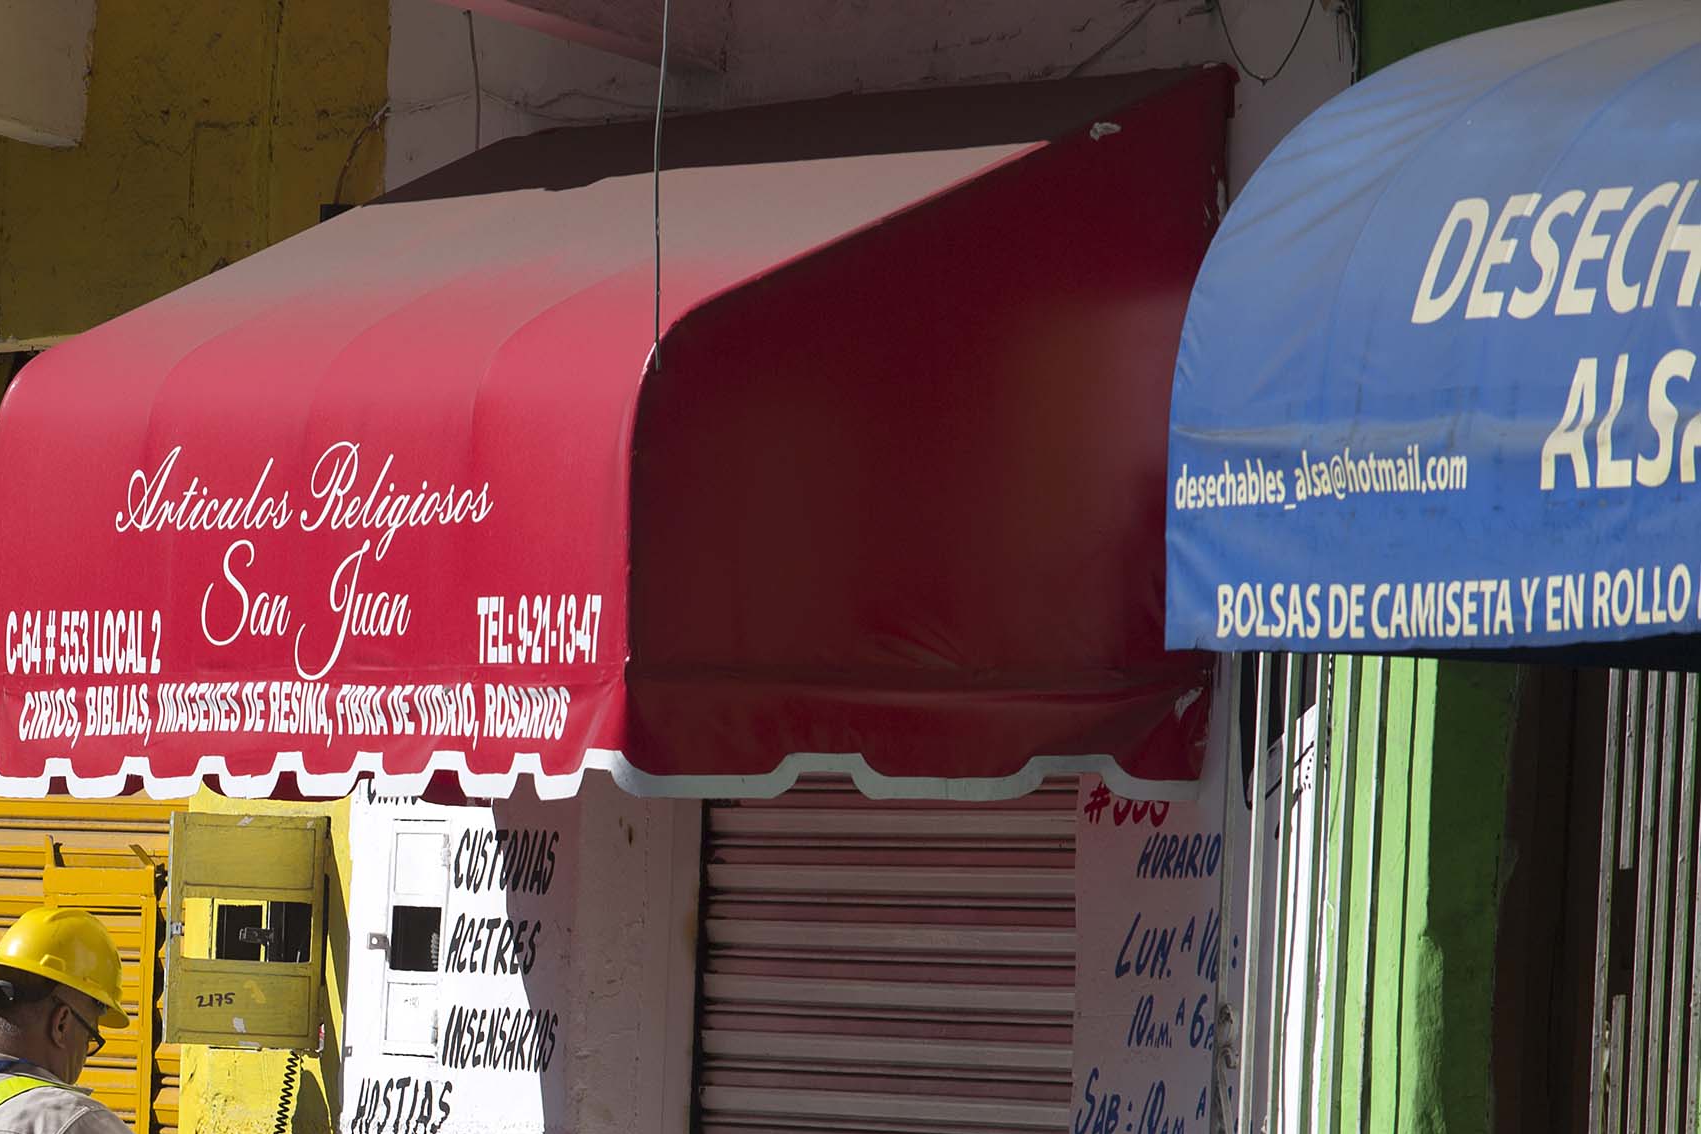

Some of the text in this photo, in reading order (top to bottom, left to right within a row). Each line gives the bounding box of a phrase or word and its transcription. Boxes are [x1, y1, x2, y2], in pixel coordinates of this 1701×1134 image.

[115, 440, 494, 561] Articulos Religiosos
[201, 538, 412, 682] San Juan
[477, 594, 602, 665] TEL: 9-21-13-47
[1216, 563, 1692, 639] BOLSAS DE CAMISETA Y EN ROLLO
[5, 609, 162, 675] C-64 # 553 LOCAL 2
[18, 681, 571, 750] CIRIOS, BIBLIAS, IMAGENES DE RESINA, FIBRA DE VIDRIO, ROSARIOS
[454, 827, 559, 895] CUSTODIAS
[1136, 832, 1221, 880] HORARIO
[446, 913, 541, 976] ACETRES
[1180, 916, 1195, 953] A
[196, 992, 235, 1008] 2175
[1175, 998, 1185, 1026] A
[441, 1005, 558, 1072] INSENSARIOS
[1195, 1087, 1206, 1120] A
